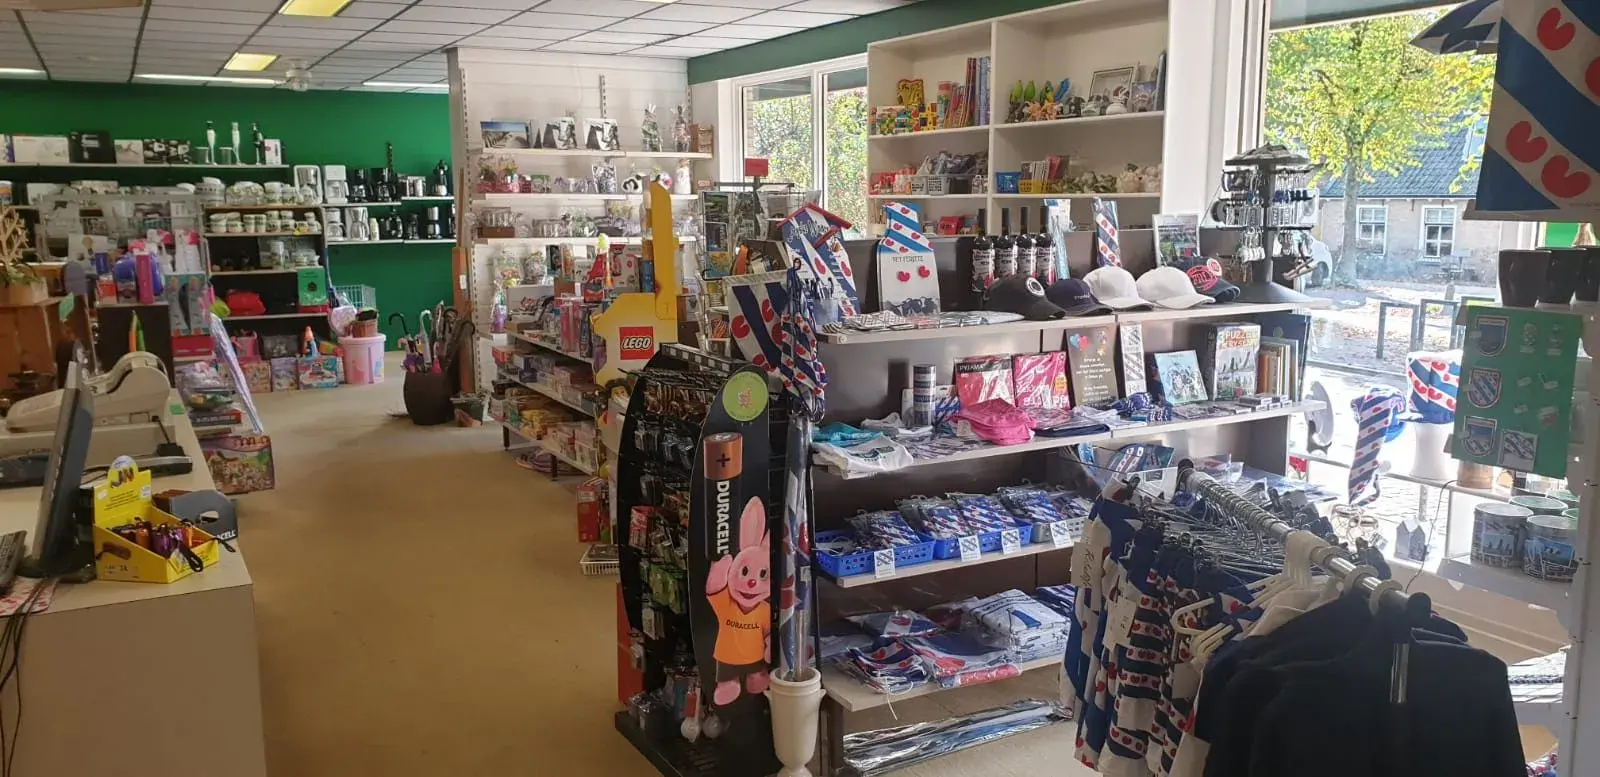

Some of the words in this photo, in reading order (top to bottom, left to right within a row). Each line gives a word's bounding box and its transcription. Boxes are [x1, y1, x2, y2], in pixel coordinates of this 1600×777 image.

[622, 336, 652, 350] LEGO
[716, 480, 730, 554] DURACELL
[725, 619, 760, 630] DURACELL
